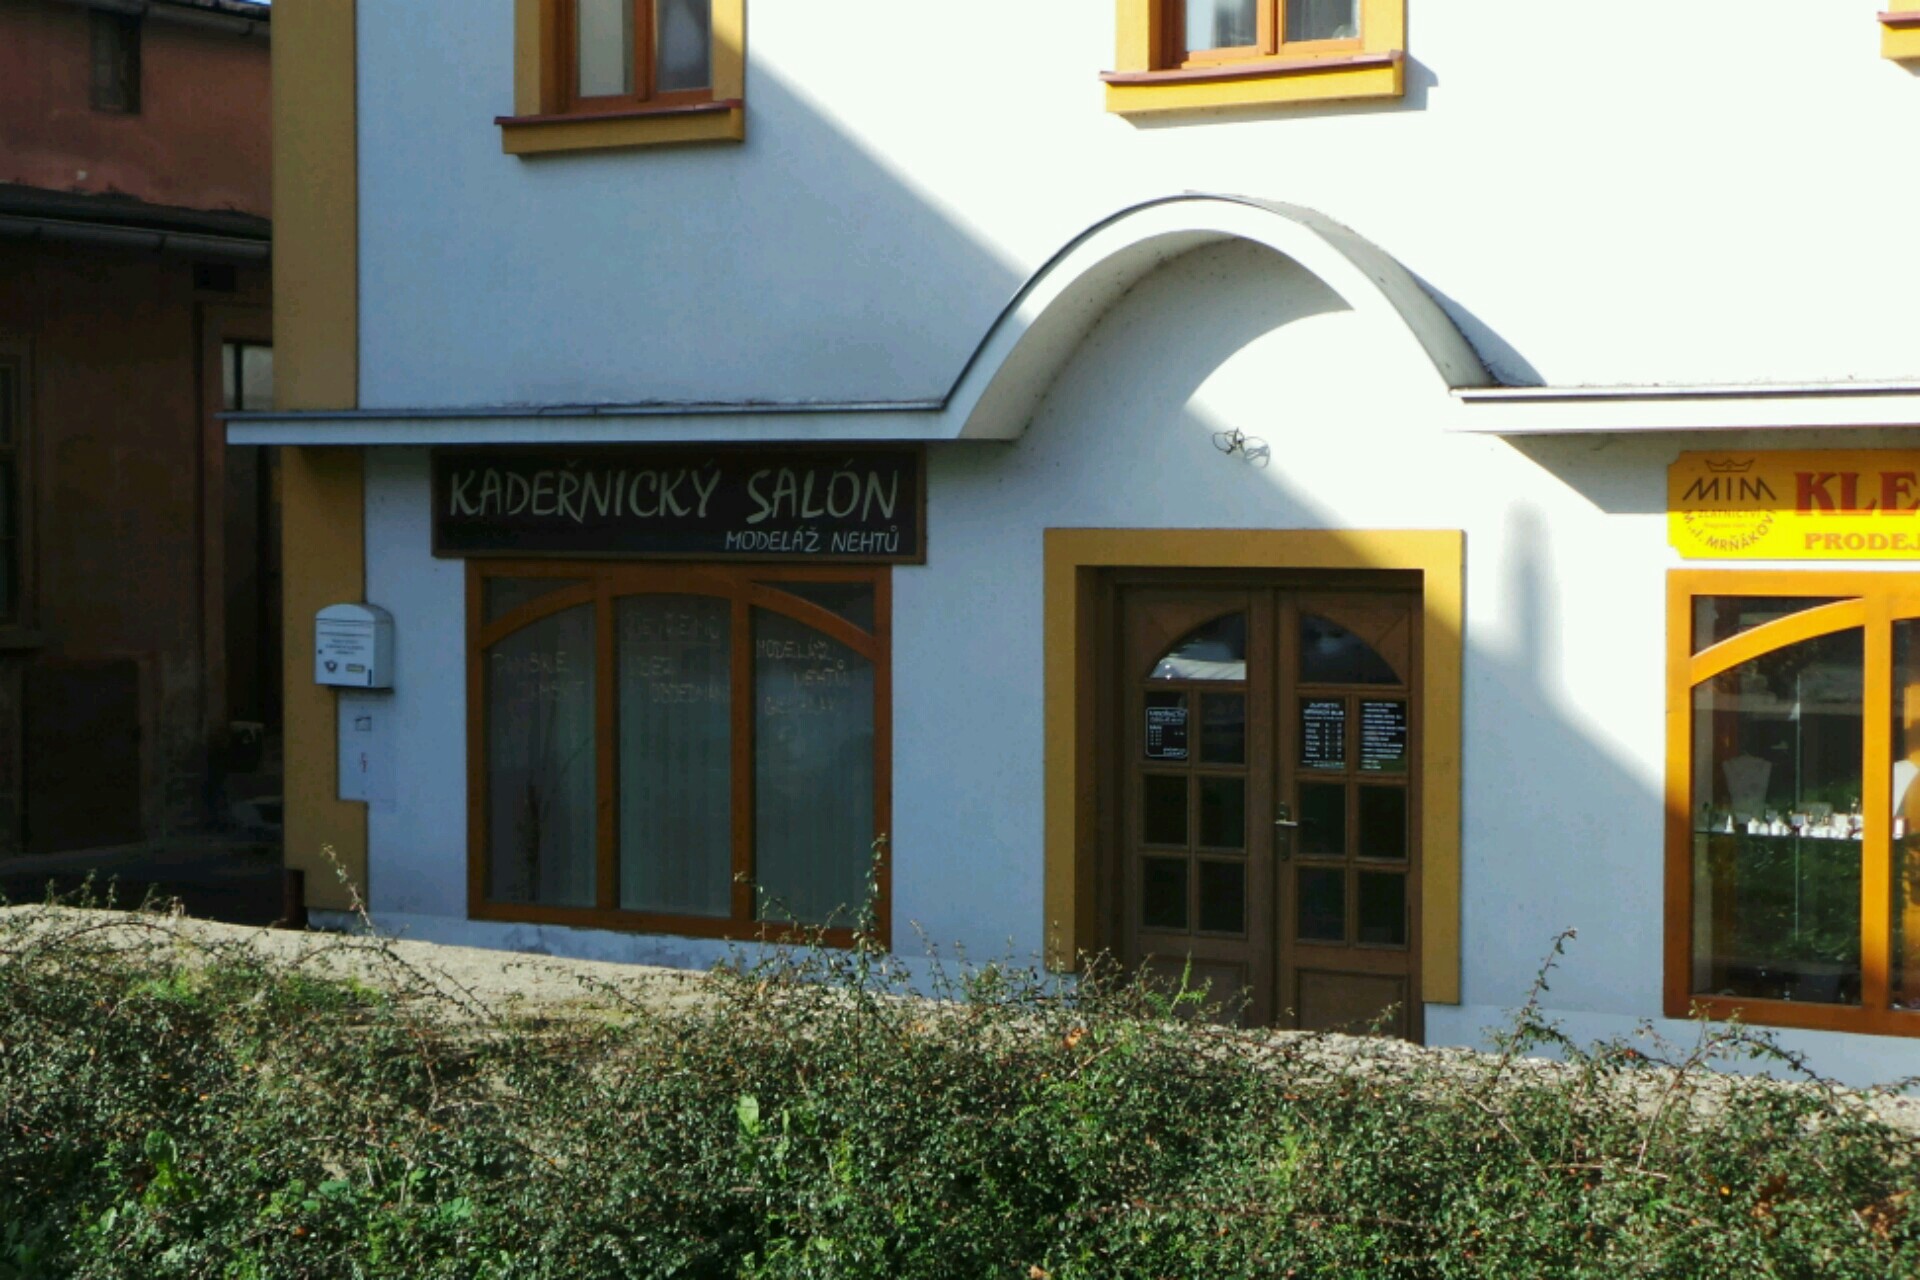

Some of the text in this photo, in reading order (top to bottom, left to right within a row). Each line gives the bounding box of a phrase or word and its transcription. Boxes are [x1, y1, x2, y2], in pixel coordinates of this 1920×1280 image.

[449, 458, 900, 525] KADEŘNICKÝ SALÓN
[1682, 476, 1777, 502] MIM
[1794, 471, 1920, 516] KLE
[724, 525, 901, 553] MODELÁŽ NEHTŮ
